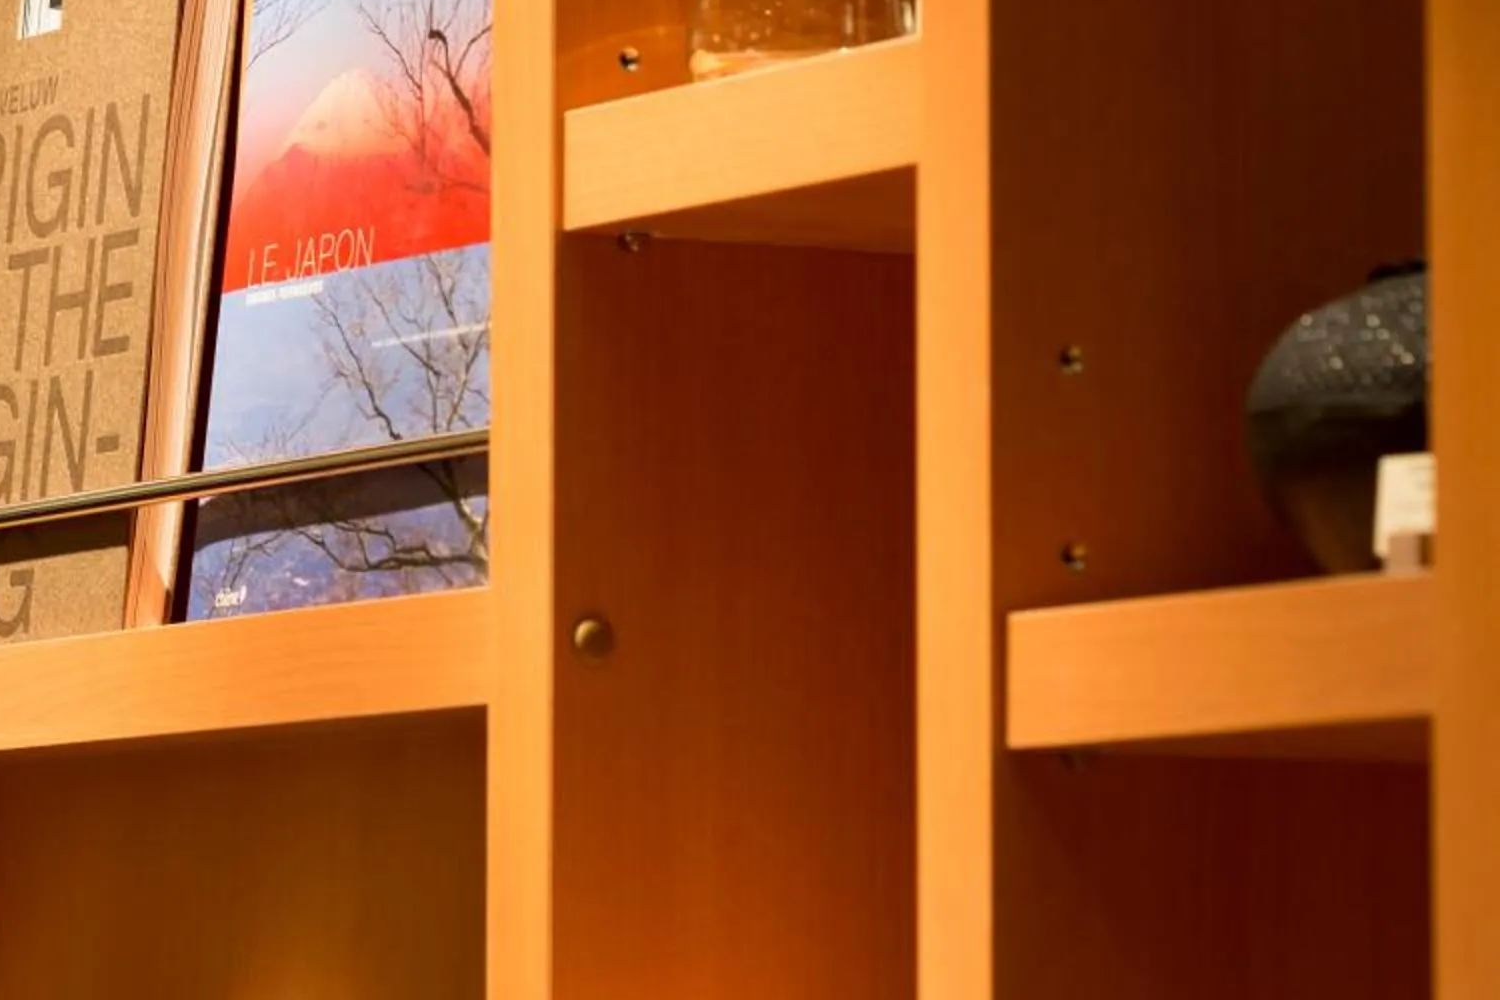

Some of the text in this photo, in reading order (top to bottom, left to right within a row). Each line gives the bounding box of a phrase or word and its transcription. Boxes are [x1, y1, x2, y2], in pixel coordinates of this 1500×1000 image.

[0, 75, 59, 116] VELUW
[247, 225, 375, 289] LE JAPON
[7, 229, 140, 372] THE
